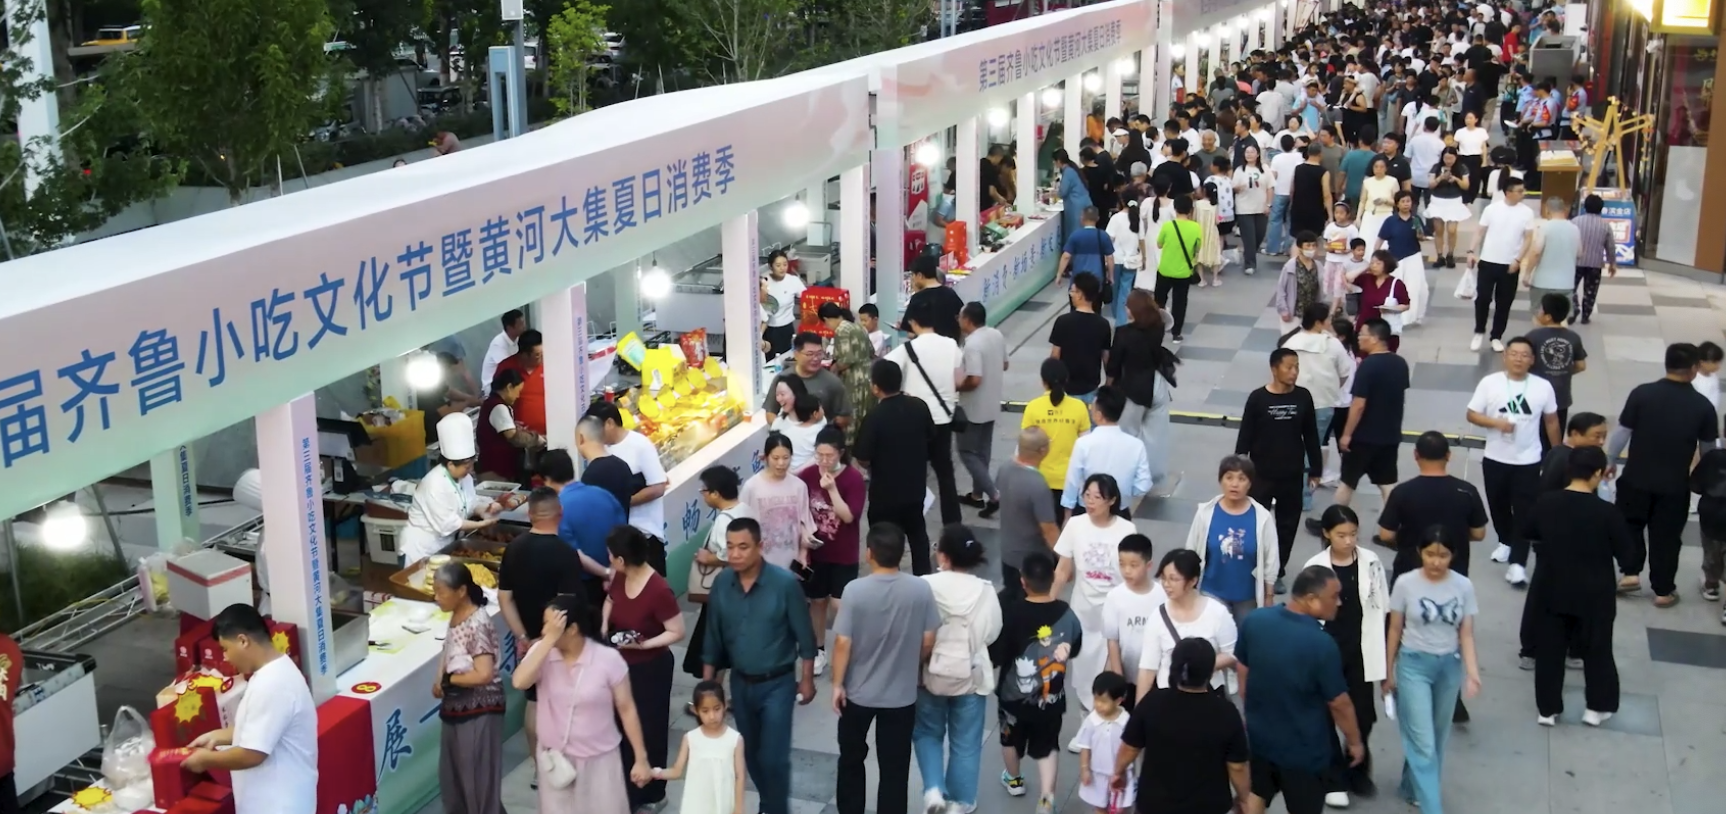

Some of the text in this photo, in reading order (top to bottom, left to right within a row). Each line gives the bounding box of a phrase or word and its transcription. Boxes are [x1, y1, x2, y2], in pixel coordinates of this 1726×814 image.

[0, 144, 735, 468] 届齐鲁小吃文化节暨黄河大集夏日消费季
